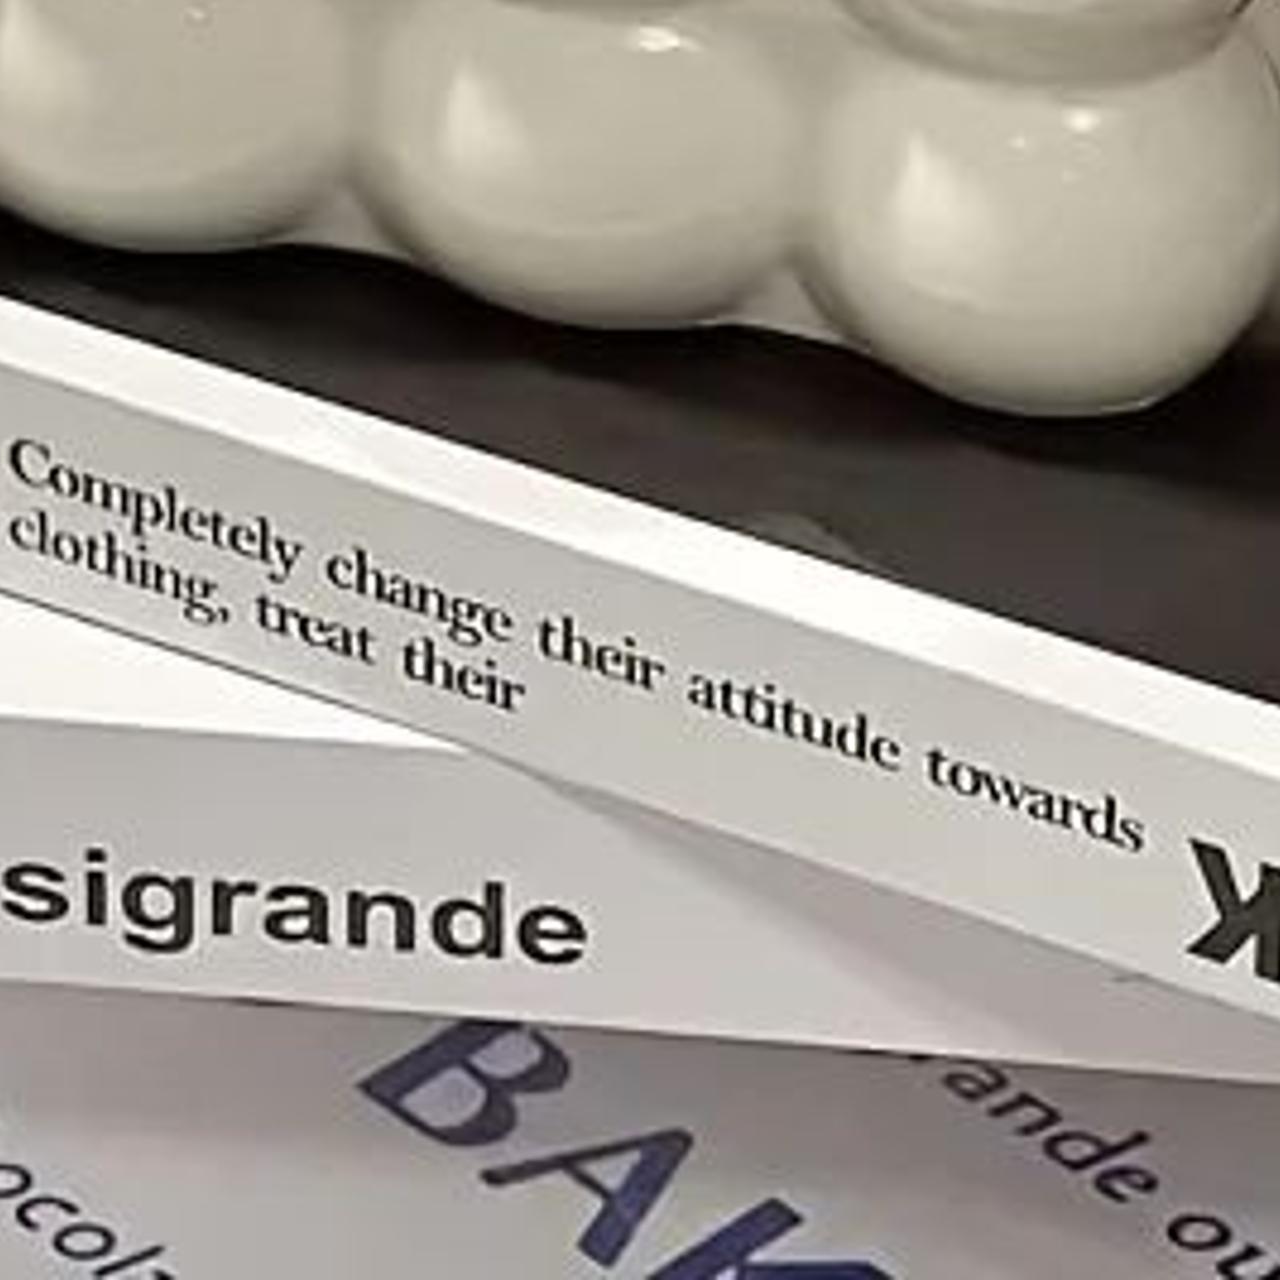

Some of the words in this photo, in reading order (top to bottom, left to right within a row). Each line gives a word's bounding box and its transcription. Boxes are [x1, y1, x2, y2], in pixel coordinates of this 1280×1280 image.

[8, 510, 231, 625] clothing,
[254, 591, 376, 665] treat
[401, 638, 527, 714] their
[8, 437, 304, 583] Completely
[324, 547, 515, 646] change
[537, 615, 666, 691] their
[686, 670, 903, 771] attitude
[924, 747, 1146, 853] towards
[0, 847, 589, 966] sigrande
[908, 1052, 1160, 1204] ande
